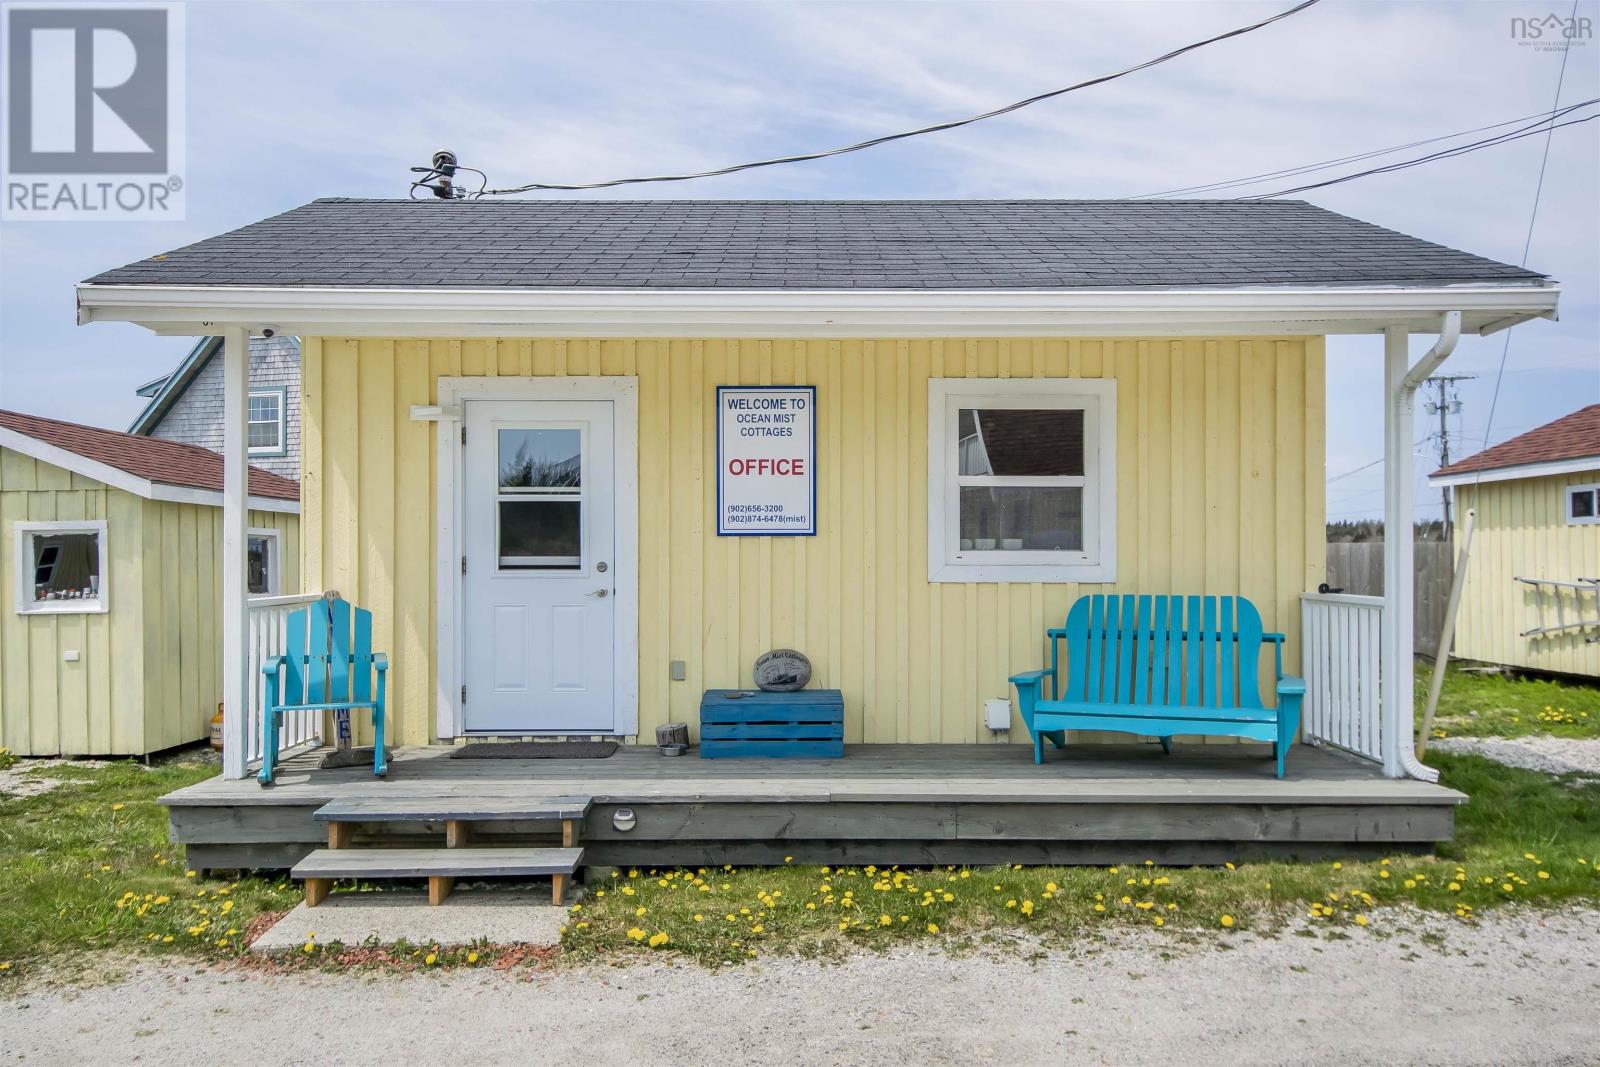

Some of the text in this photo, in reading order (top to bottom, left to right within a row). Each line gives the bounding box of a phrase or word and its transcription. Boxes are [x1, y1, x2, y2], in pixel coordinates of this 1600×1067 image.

[728, 398, 806, 410] WELCOME TO
[737, 413, 796, 423] OCEAN MIST
[740, 427, 793, 437] COTTAGES
[729, 458, 804, 476] OFFICE
[728, 505, 783, 513] (902)656-3200
